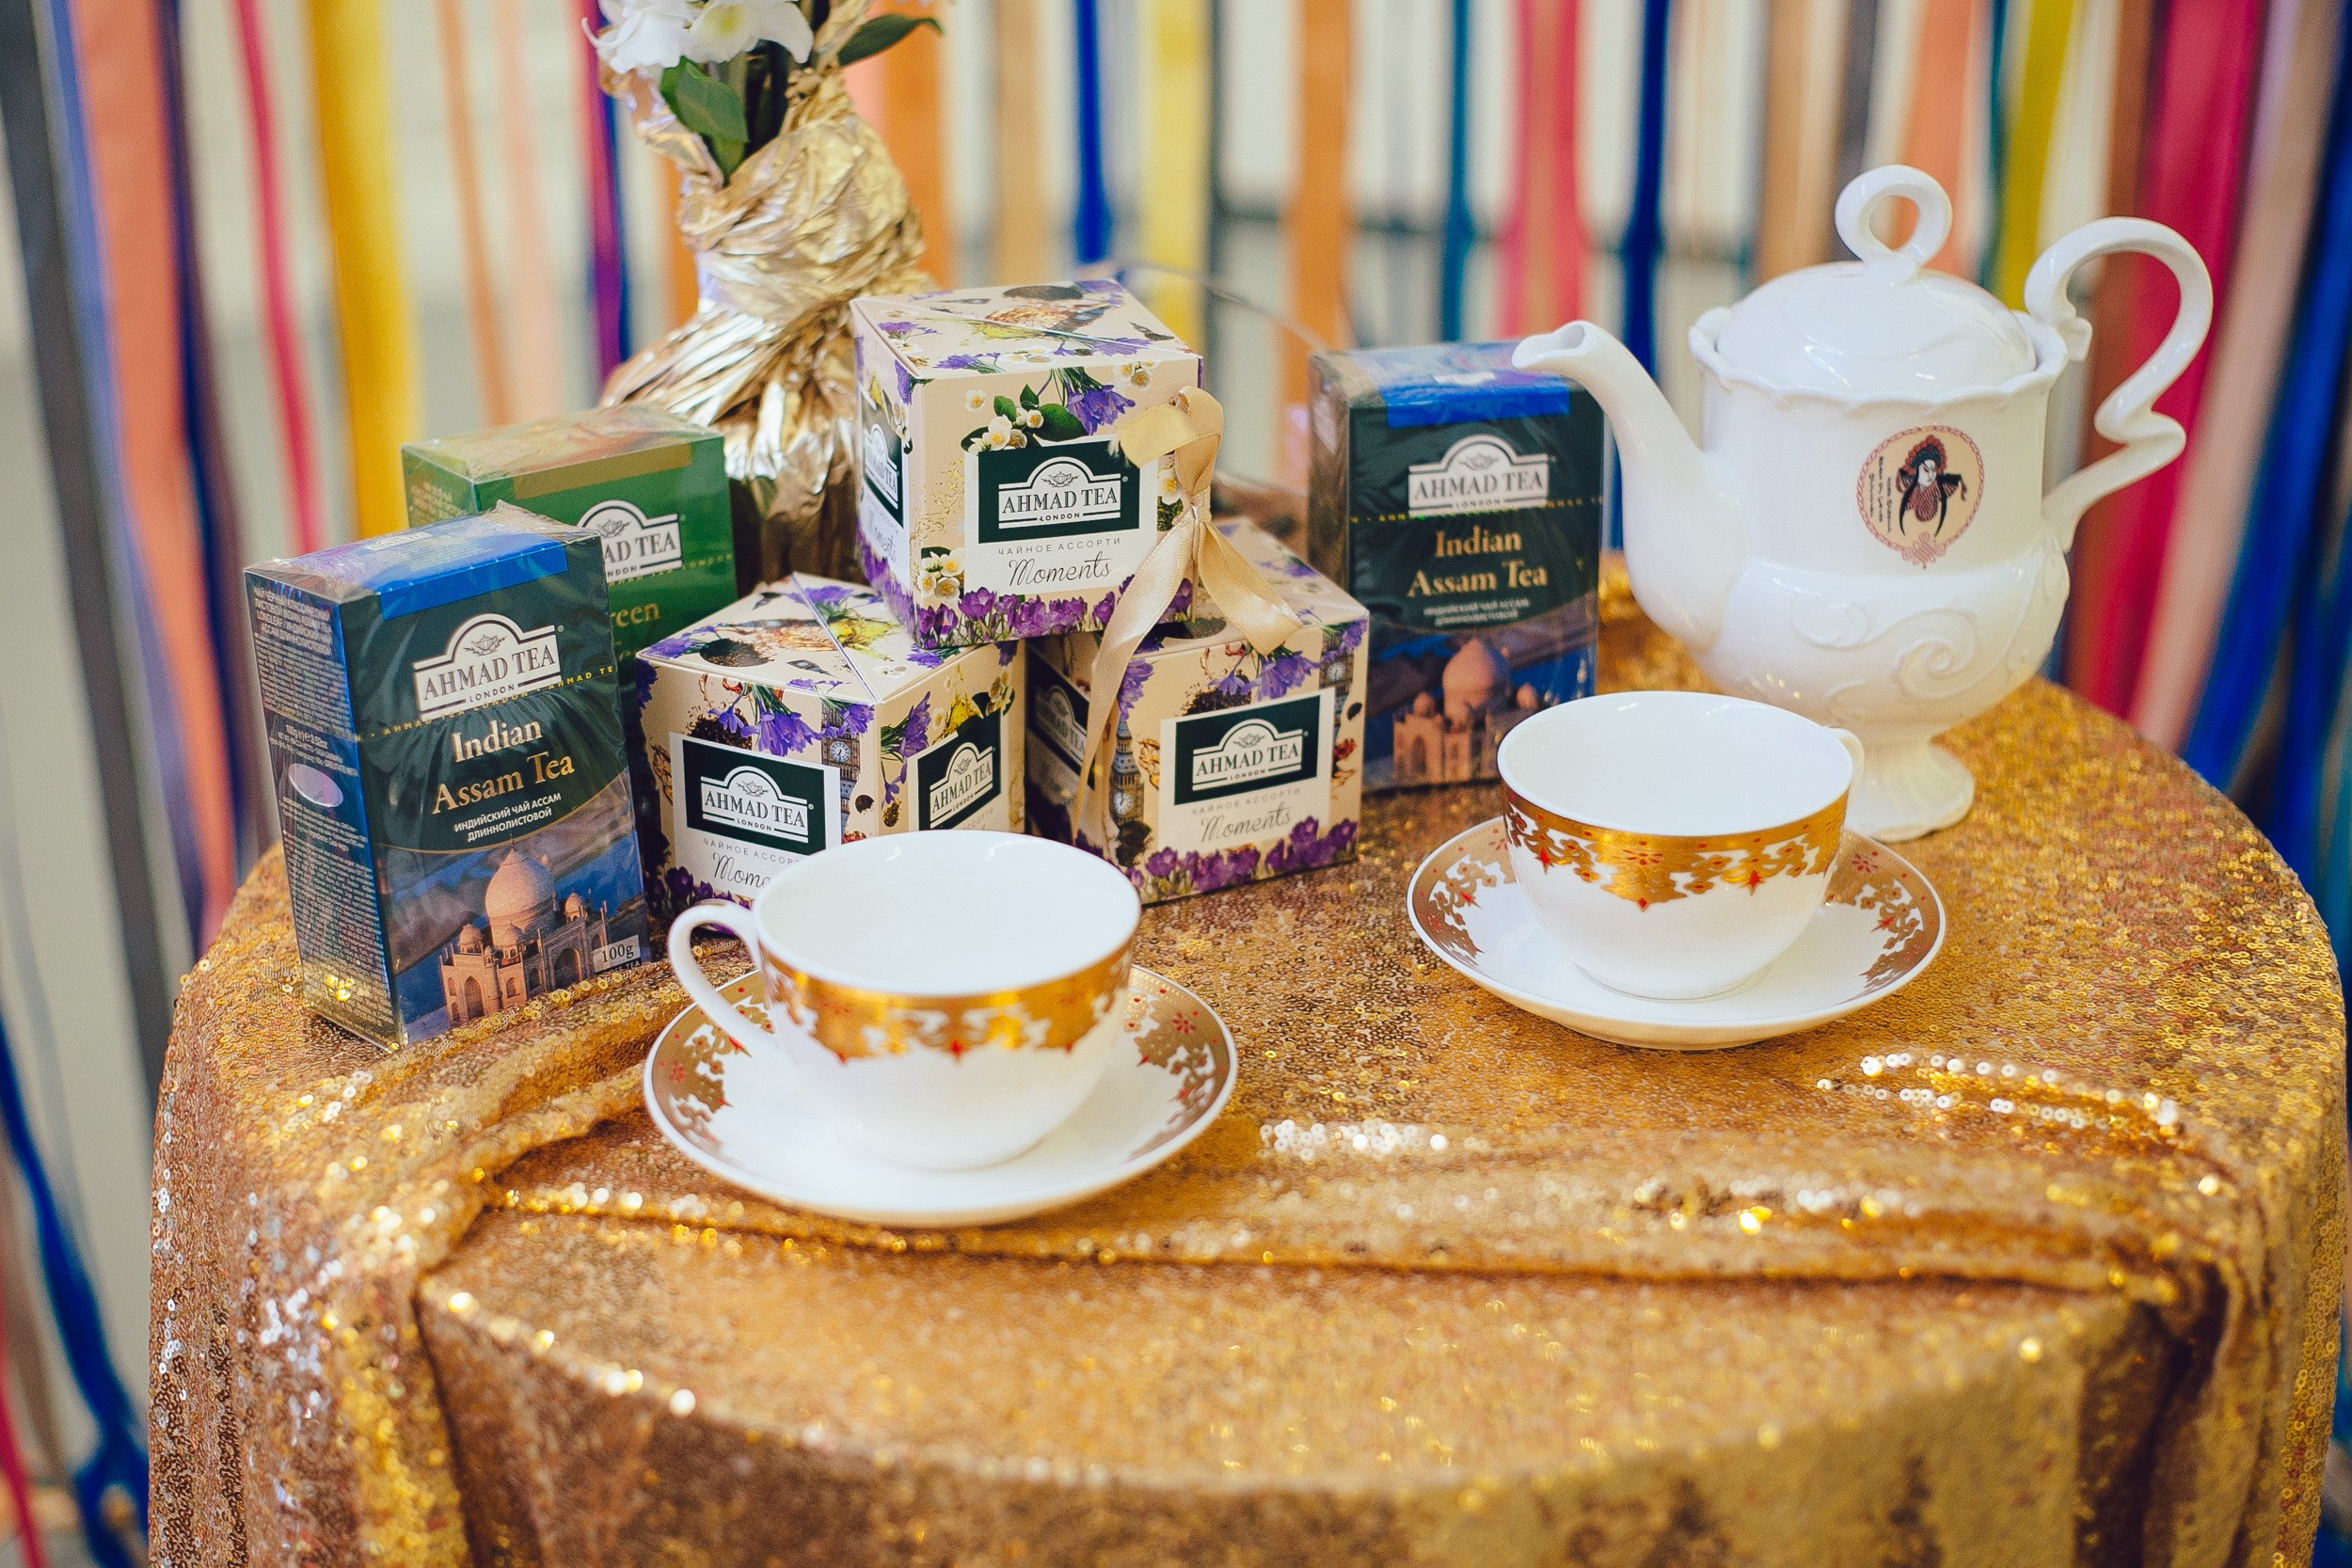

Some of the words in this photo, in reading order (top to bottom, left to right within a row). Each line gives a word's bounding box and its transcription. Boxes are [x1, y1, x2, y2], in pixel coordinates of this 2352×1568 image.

[1002, 490, 1077, 515] AHMAD
[1081, 486, 1118, 507] TEA
[1415, 473, 1498, 500] AHMAD
[1502, 470, 1544, 492] TEA
[1039, 512, 1081, 522] LONDON
[635, 531, 676, 558] TEA
[998, 543, 1052, 556] ЧАЙНОЕ
[1057, 537, 1120, 550] АССОРТИ
[1435, 525, 1522, 558] Indian
[607, 565, 637, 578] NDON
[1009, 551, 1112, 587] Moments
[1406, 570, 1498, 598] Assam
[1501, 559, 1549, 589] Tea
[423, 657, 509, 702] AHMAD
[511, 644, 557, 675] TEA
[382, 718, 432, 736] AHMAD
[472, 691, 529, 712] LONDON
[548, 672, 593, 690] AHMAD
[599, 665, 613, 675] TE
[469, 683, 516, 703] LONDON
[452, 720, 543, 763] Indian
[1196, 749, 1263, 776] AHMAD
[1267, 742, 1299, 762] TEA
[1230, 768, 1265, 781] LONDON
[432, 771, 524, 815] Assam
[527, 752, 575, 784] Tea
[931, 773, 972, 815] AHMAD
[973, 760, 992, 786] TEA
[453, 806, 512, 832] ИНДИЙСКИЙ
[512, 800, 531, 815] ЧАЙ
[532, 792, 562, 810] АССАМ
[705, 790, 769, 819] AHMAD
[771, 805, 806, 828] TEA
[953, 795, 975, 812] LONDON
[1191, 800, 1240, 815] ЧАЙНОЕ
[1245, 787, 1300, 805] АССОРТИ
[468, 806, 552, 843] ДЛИННОЛИСТОВОЙ
[737, 817, 772, 832] LONDON
[1200, 801, 1292, 843] Moments
[703, 837, 749, 856] ЧАЙНОЕ
[754, 850, 800, 865] АССОР
[712, 852, 771, 888] Mome
[602, 943, 634, 963] 100g
